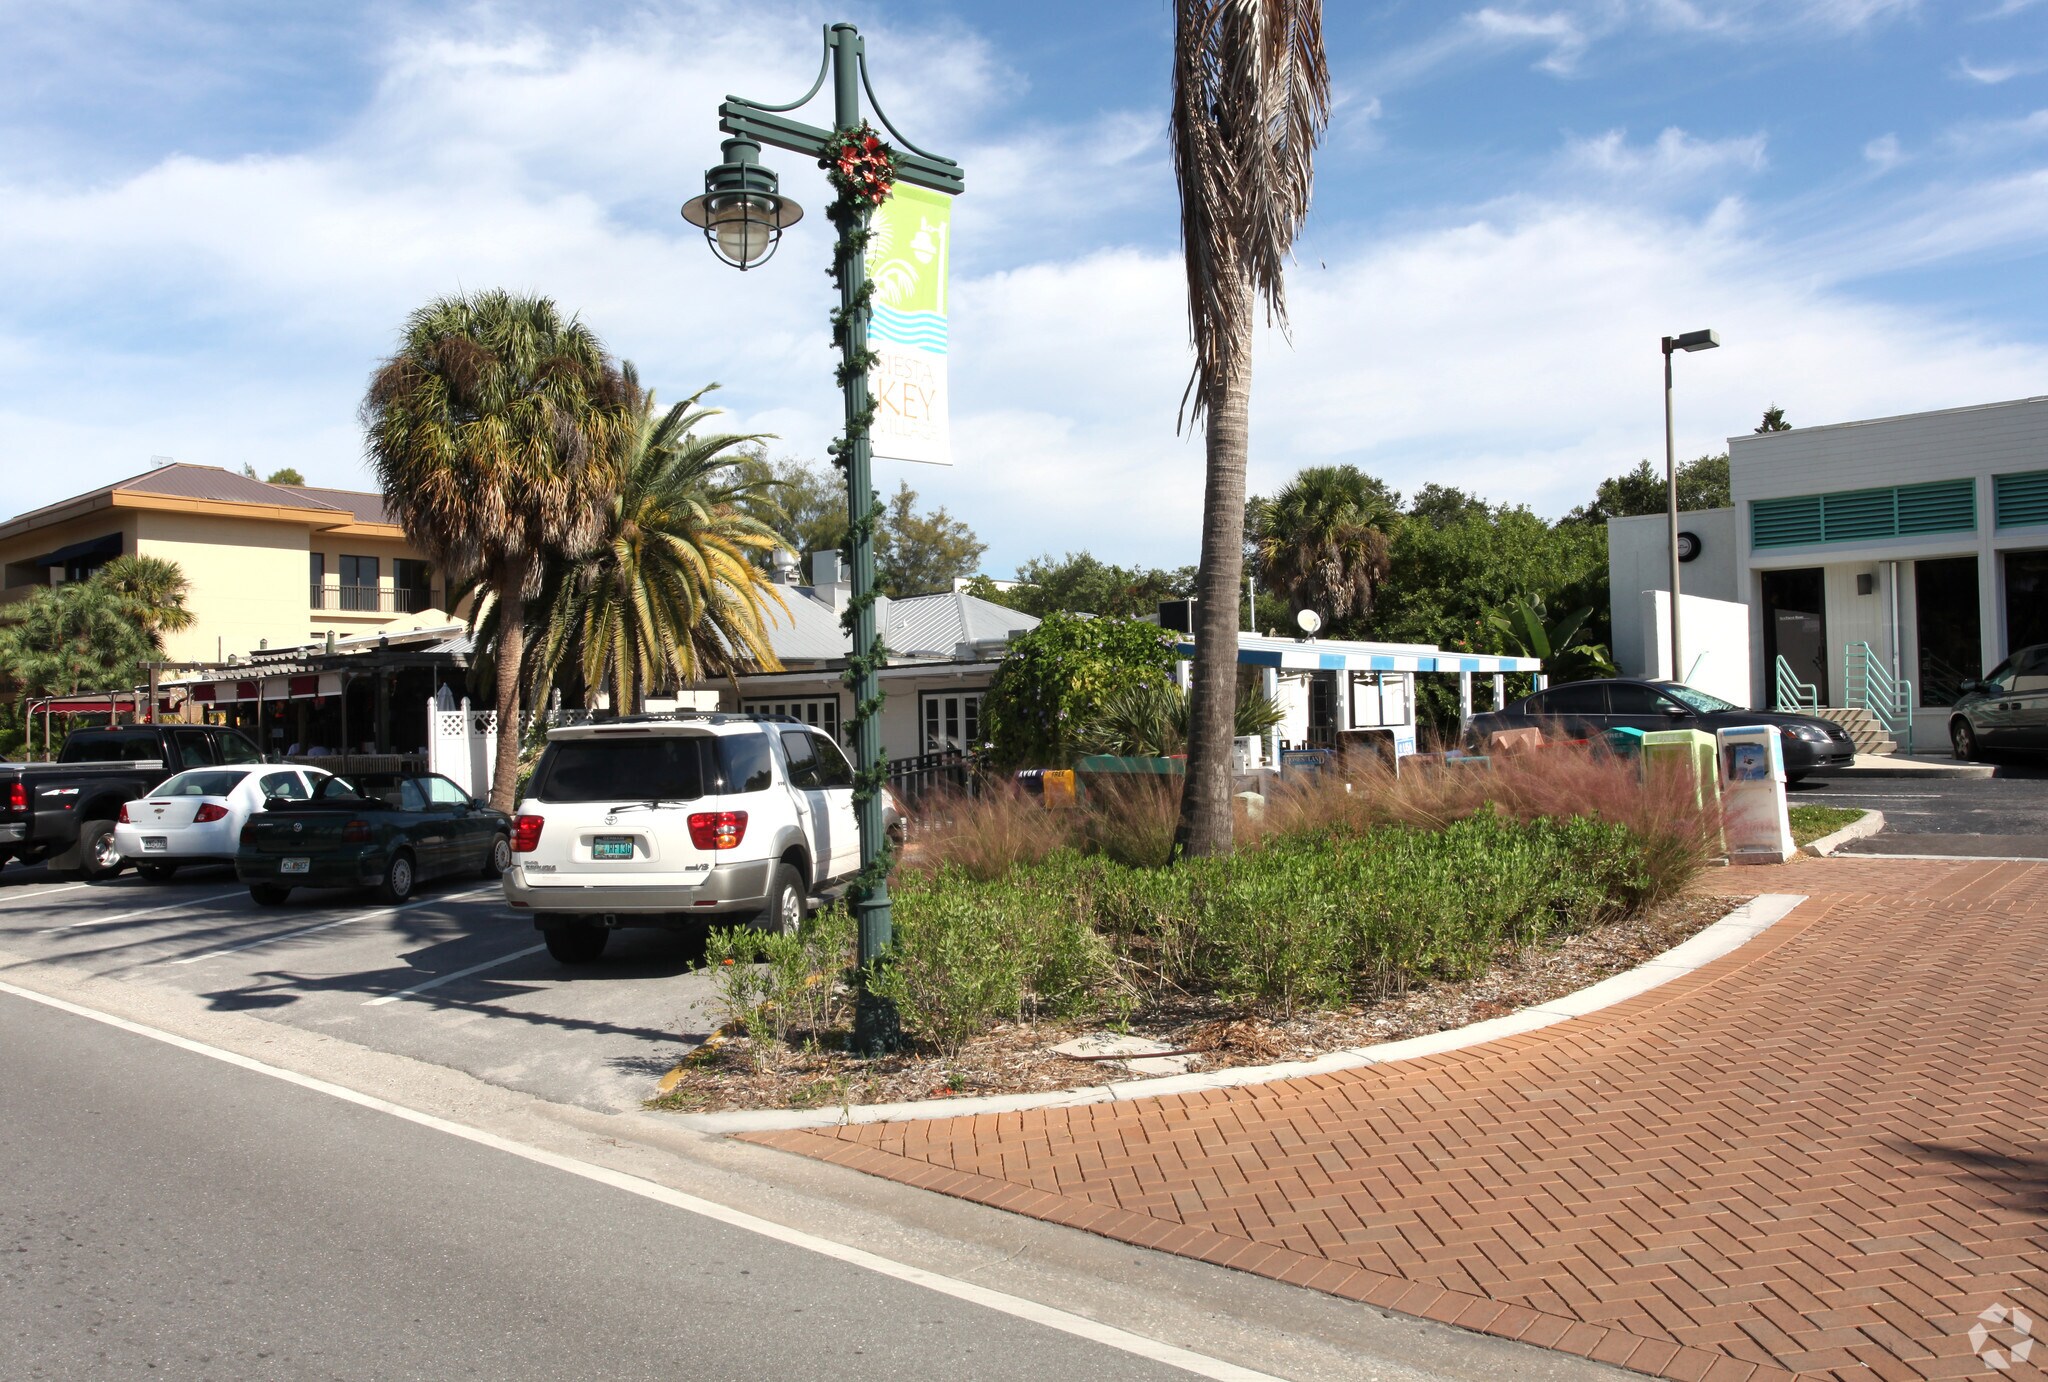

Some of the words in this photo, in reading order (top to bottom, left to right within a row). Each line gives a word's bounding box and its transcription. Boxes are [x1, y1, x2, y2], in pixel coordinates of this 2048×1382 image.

[878, 378, 936, 421] KEY
[1657, 734, 1680, 742] FREE
[1051, 770, 1065, 778] FREE
